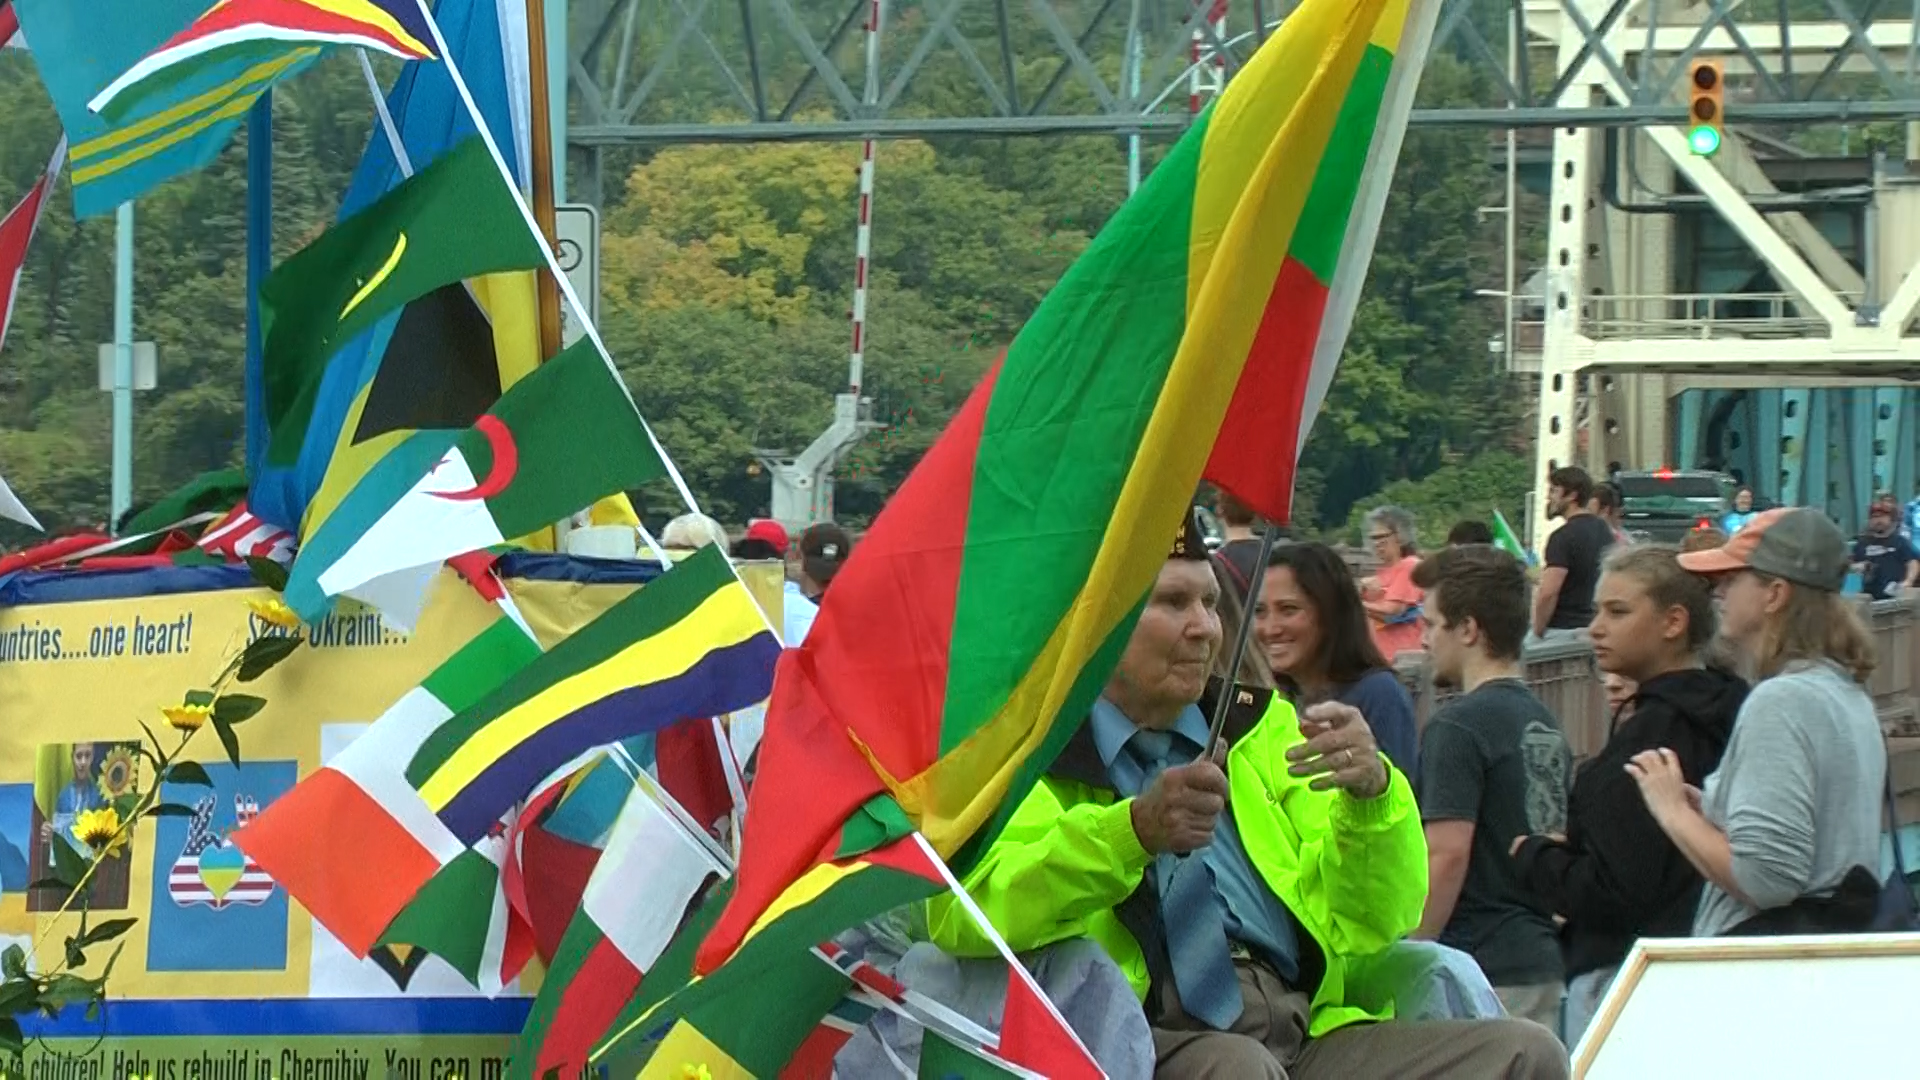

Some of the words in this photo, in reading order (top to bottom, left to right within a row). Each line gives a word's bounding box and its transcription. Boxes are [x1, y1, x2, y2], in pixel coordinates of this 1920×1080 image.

[132, 612, 192, 656] heart!
[31, 1049, 104, 1080] children!
[156, 1058, 176, 1080] us
[183, 1049, 248, 1080] rebuild
[254, 1049, 271, 1080] in
